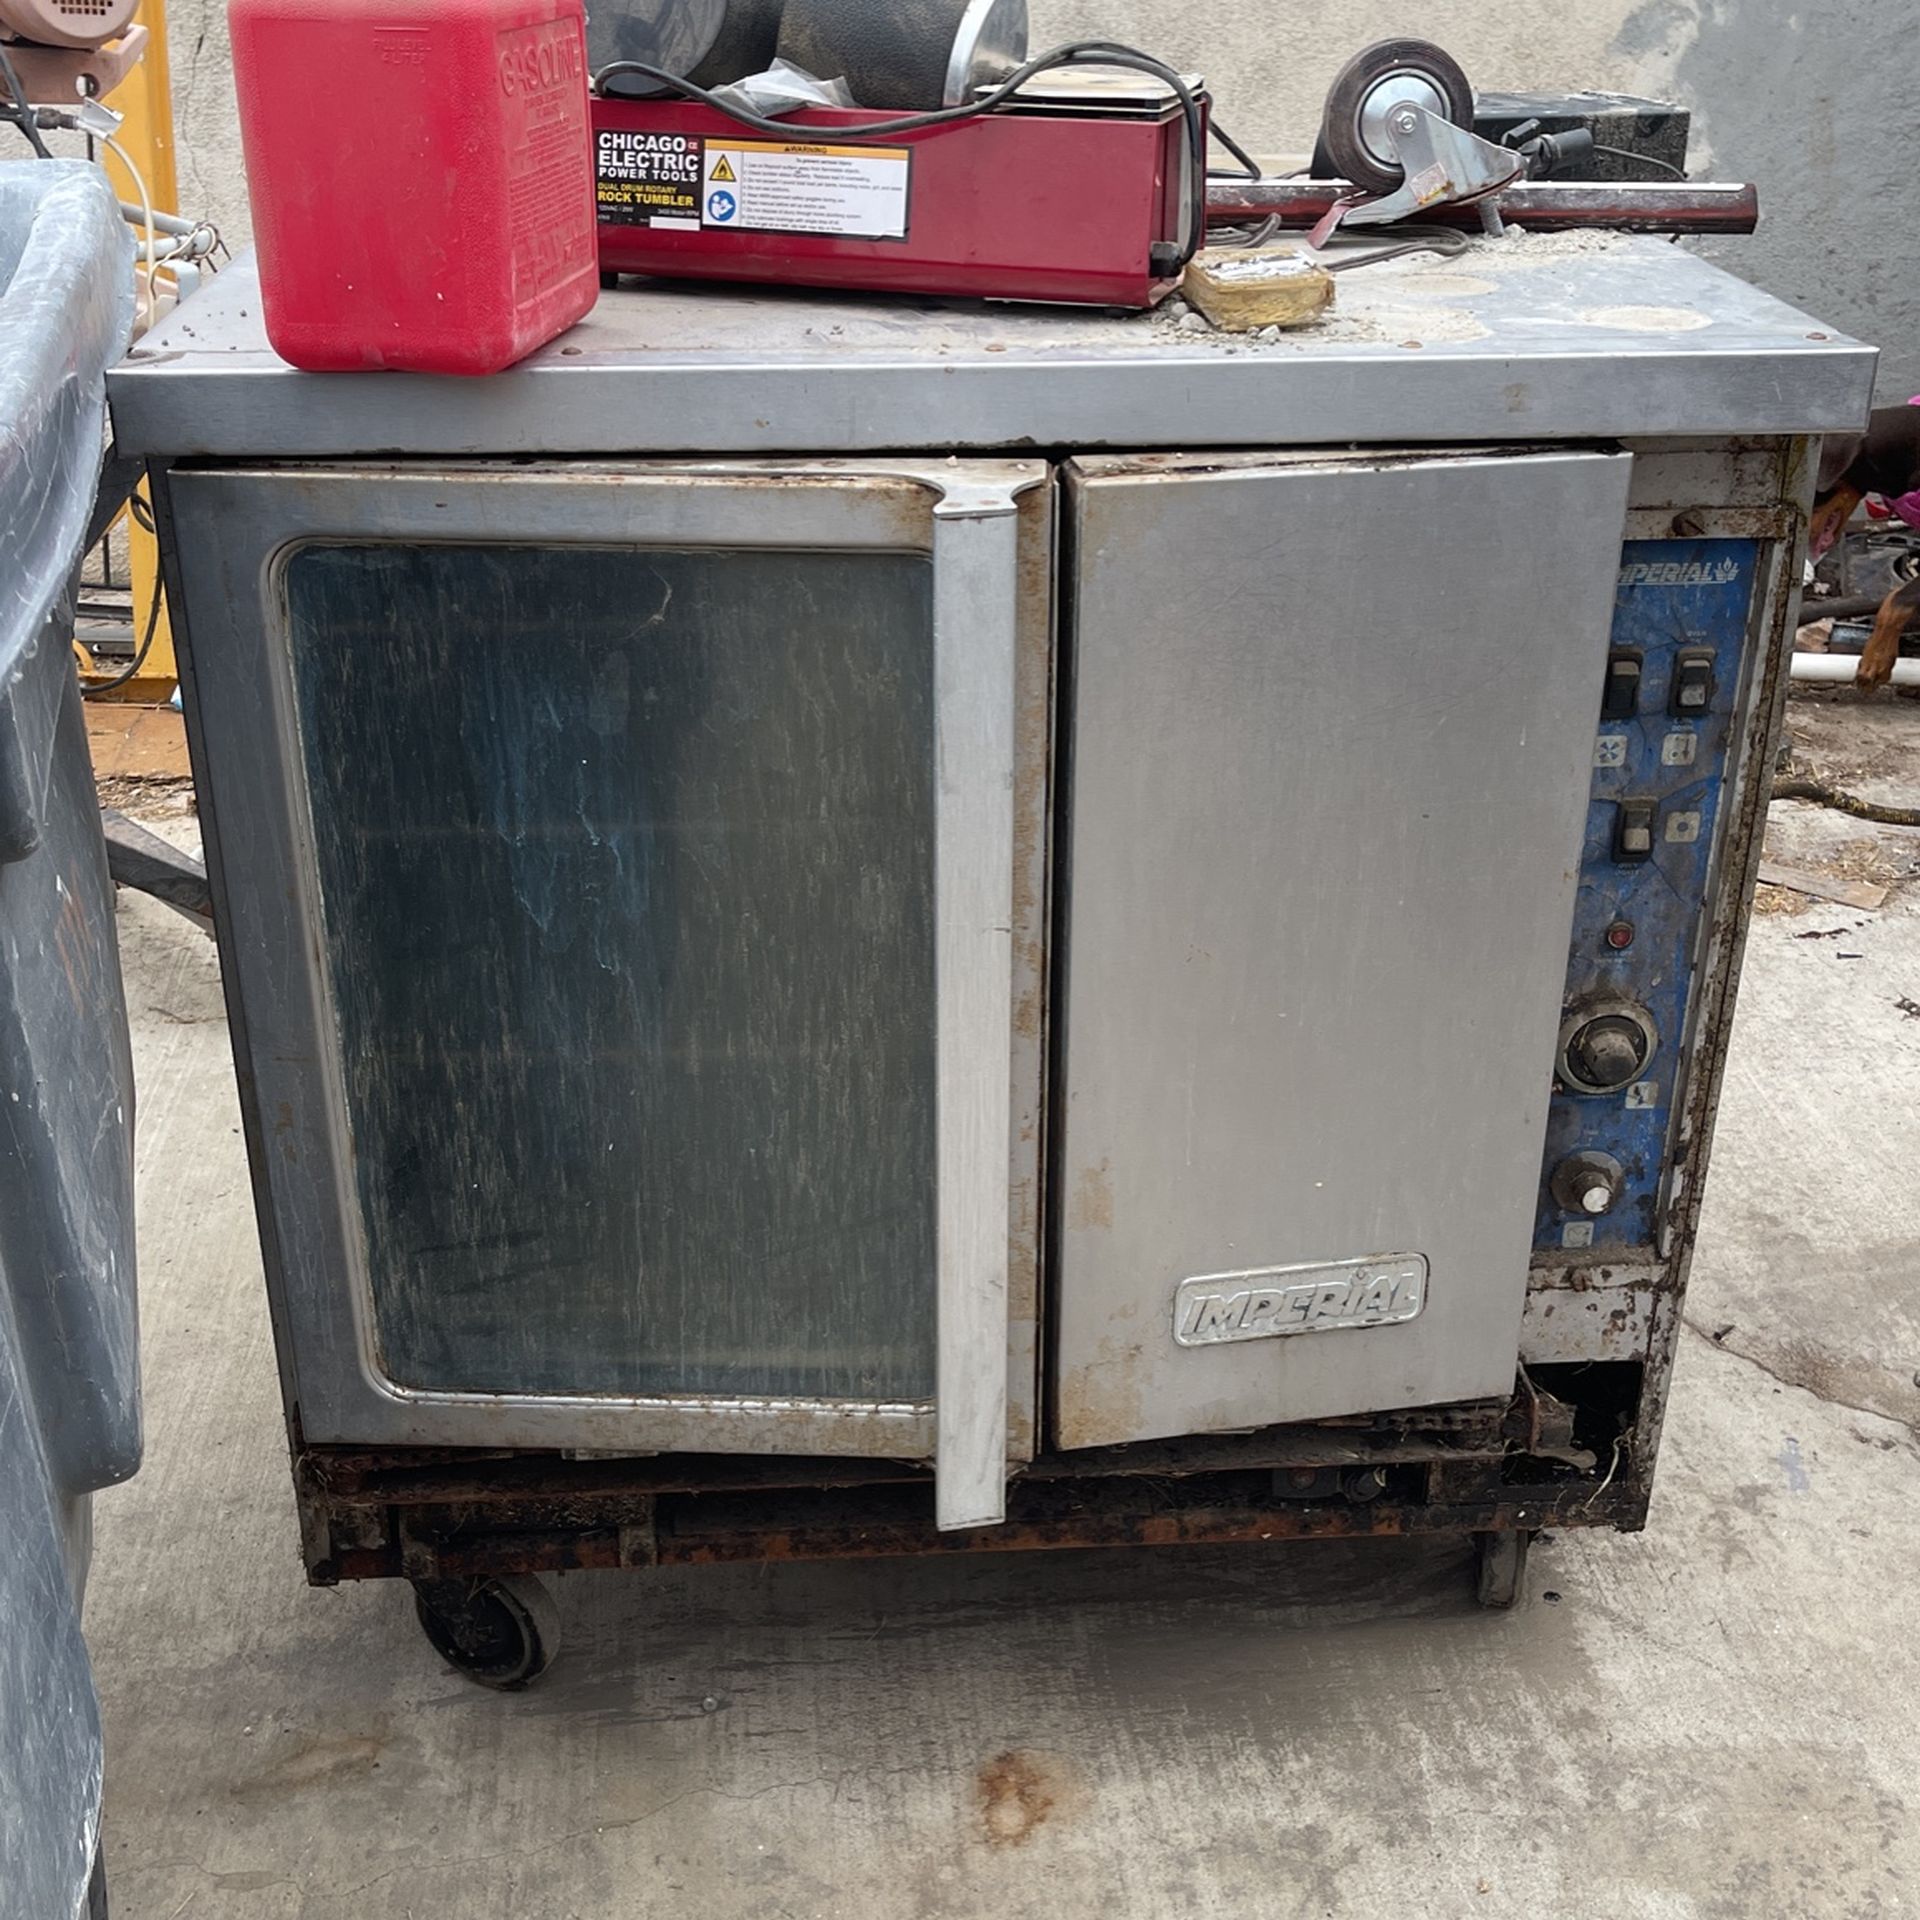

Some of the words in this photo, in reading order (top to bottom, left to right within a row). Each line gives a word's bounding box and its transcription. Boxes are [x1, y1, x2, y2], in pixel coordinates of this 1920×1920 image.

[499, 34, 583, 97] GASOLINE
[598, 132, 686, 152] CHICAGO
[788, 146, 828, 154] WARNING
[598, 150, 699, 171] ELECTRIC
[598, 167, 647, 179] POWER
[652, 170, 698, 182] TOOLS
[597, 183, 619, 191] DUAL
[620, 184, 645, 192] DRUM
[645, 185, 678, 194] ROTARY
[597, 191, 632, 203] ROCK
[634, 193, 694, 206] TUMBLER
[1181, 1268, 1418, 1336] IMPERIAL
